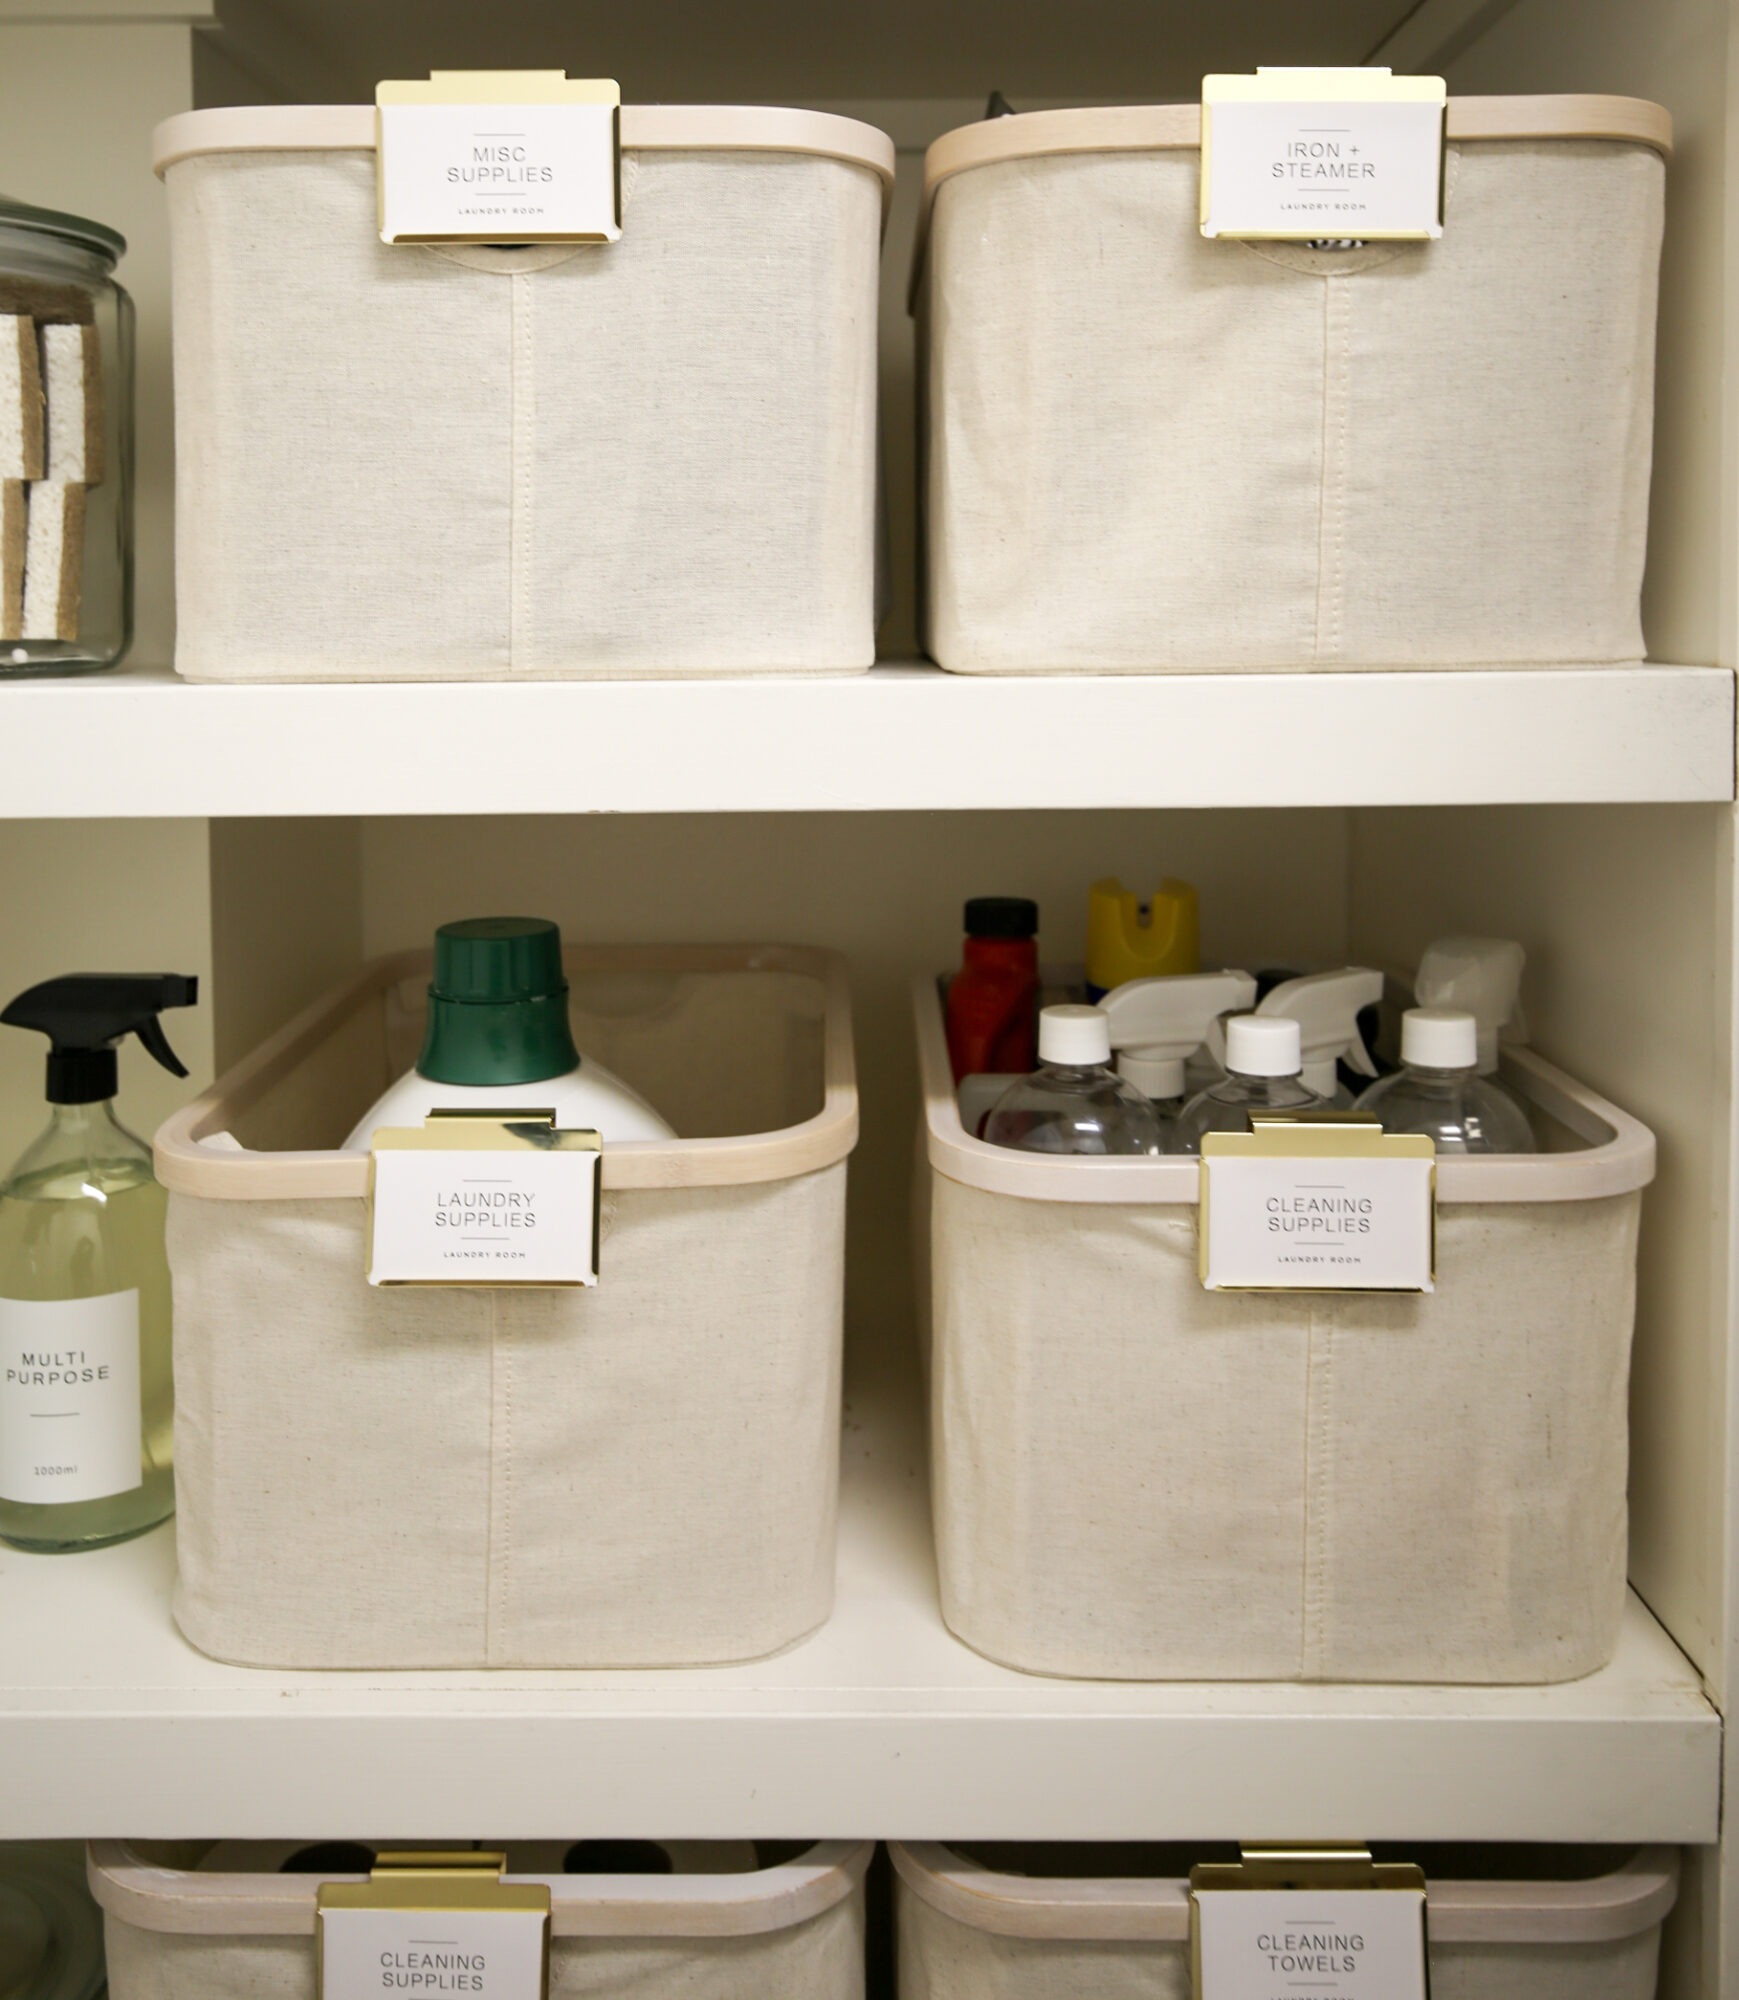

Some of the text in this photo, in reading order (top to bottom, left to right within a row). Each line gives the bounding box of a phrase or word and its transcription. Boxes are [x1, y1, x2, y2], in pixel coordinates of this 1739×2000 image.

[473, 146, 526, 162] MISC
[1287, 142, 1340, 158] IRON
[447, 166, 553, 183] SUPPLIES
[1272, 162, 1376, 178] STEAMER
[437, 1192, 536, 1208] LAUNDRY
[1266, 1197, 1373, 1214] CLEANING
[435, 1211, 536, 1228] SUPPLIES
[1268, 1217, 1371, 1233] SUPPLIES
[443, 1251, 527, 1259] LAUNDRY ROOM
[1278, 1255, 1362, 1264] LAUNDRY ROOM
[22, 1351, 85, 1367] MULTI
[6, 1365, 110, 1386] PURPOSE
[34, 1465, 78, 1477] 1000ml
[1257, 1934, 1365, 1952] CLEANING
[380, 1952, 486, 1971] CLEANING
[1267, 1955, 1356, 1973] TOWELS
[382, 1972, 484, 1991] SUPPLIES
